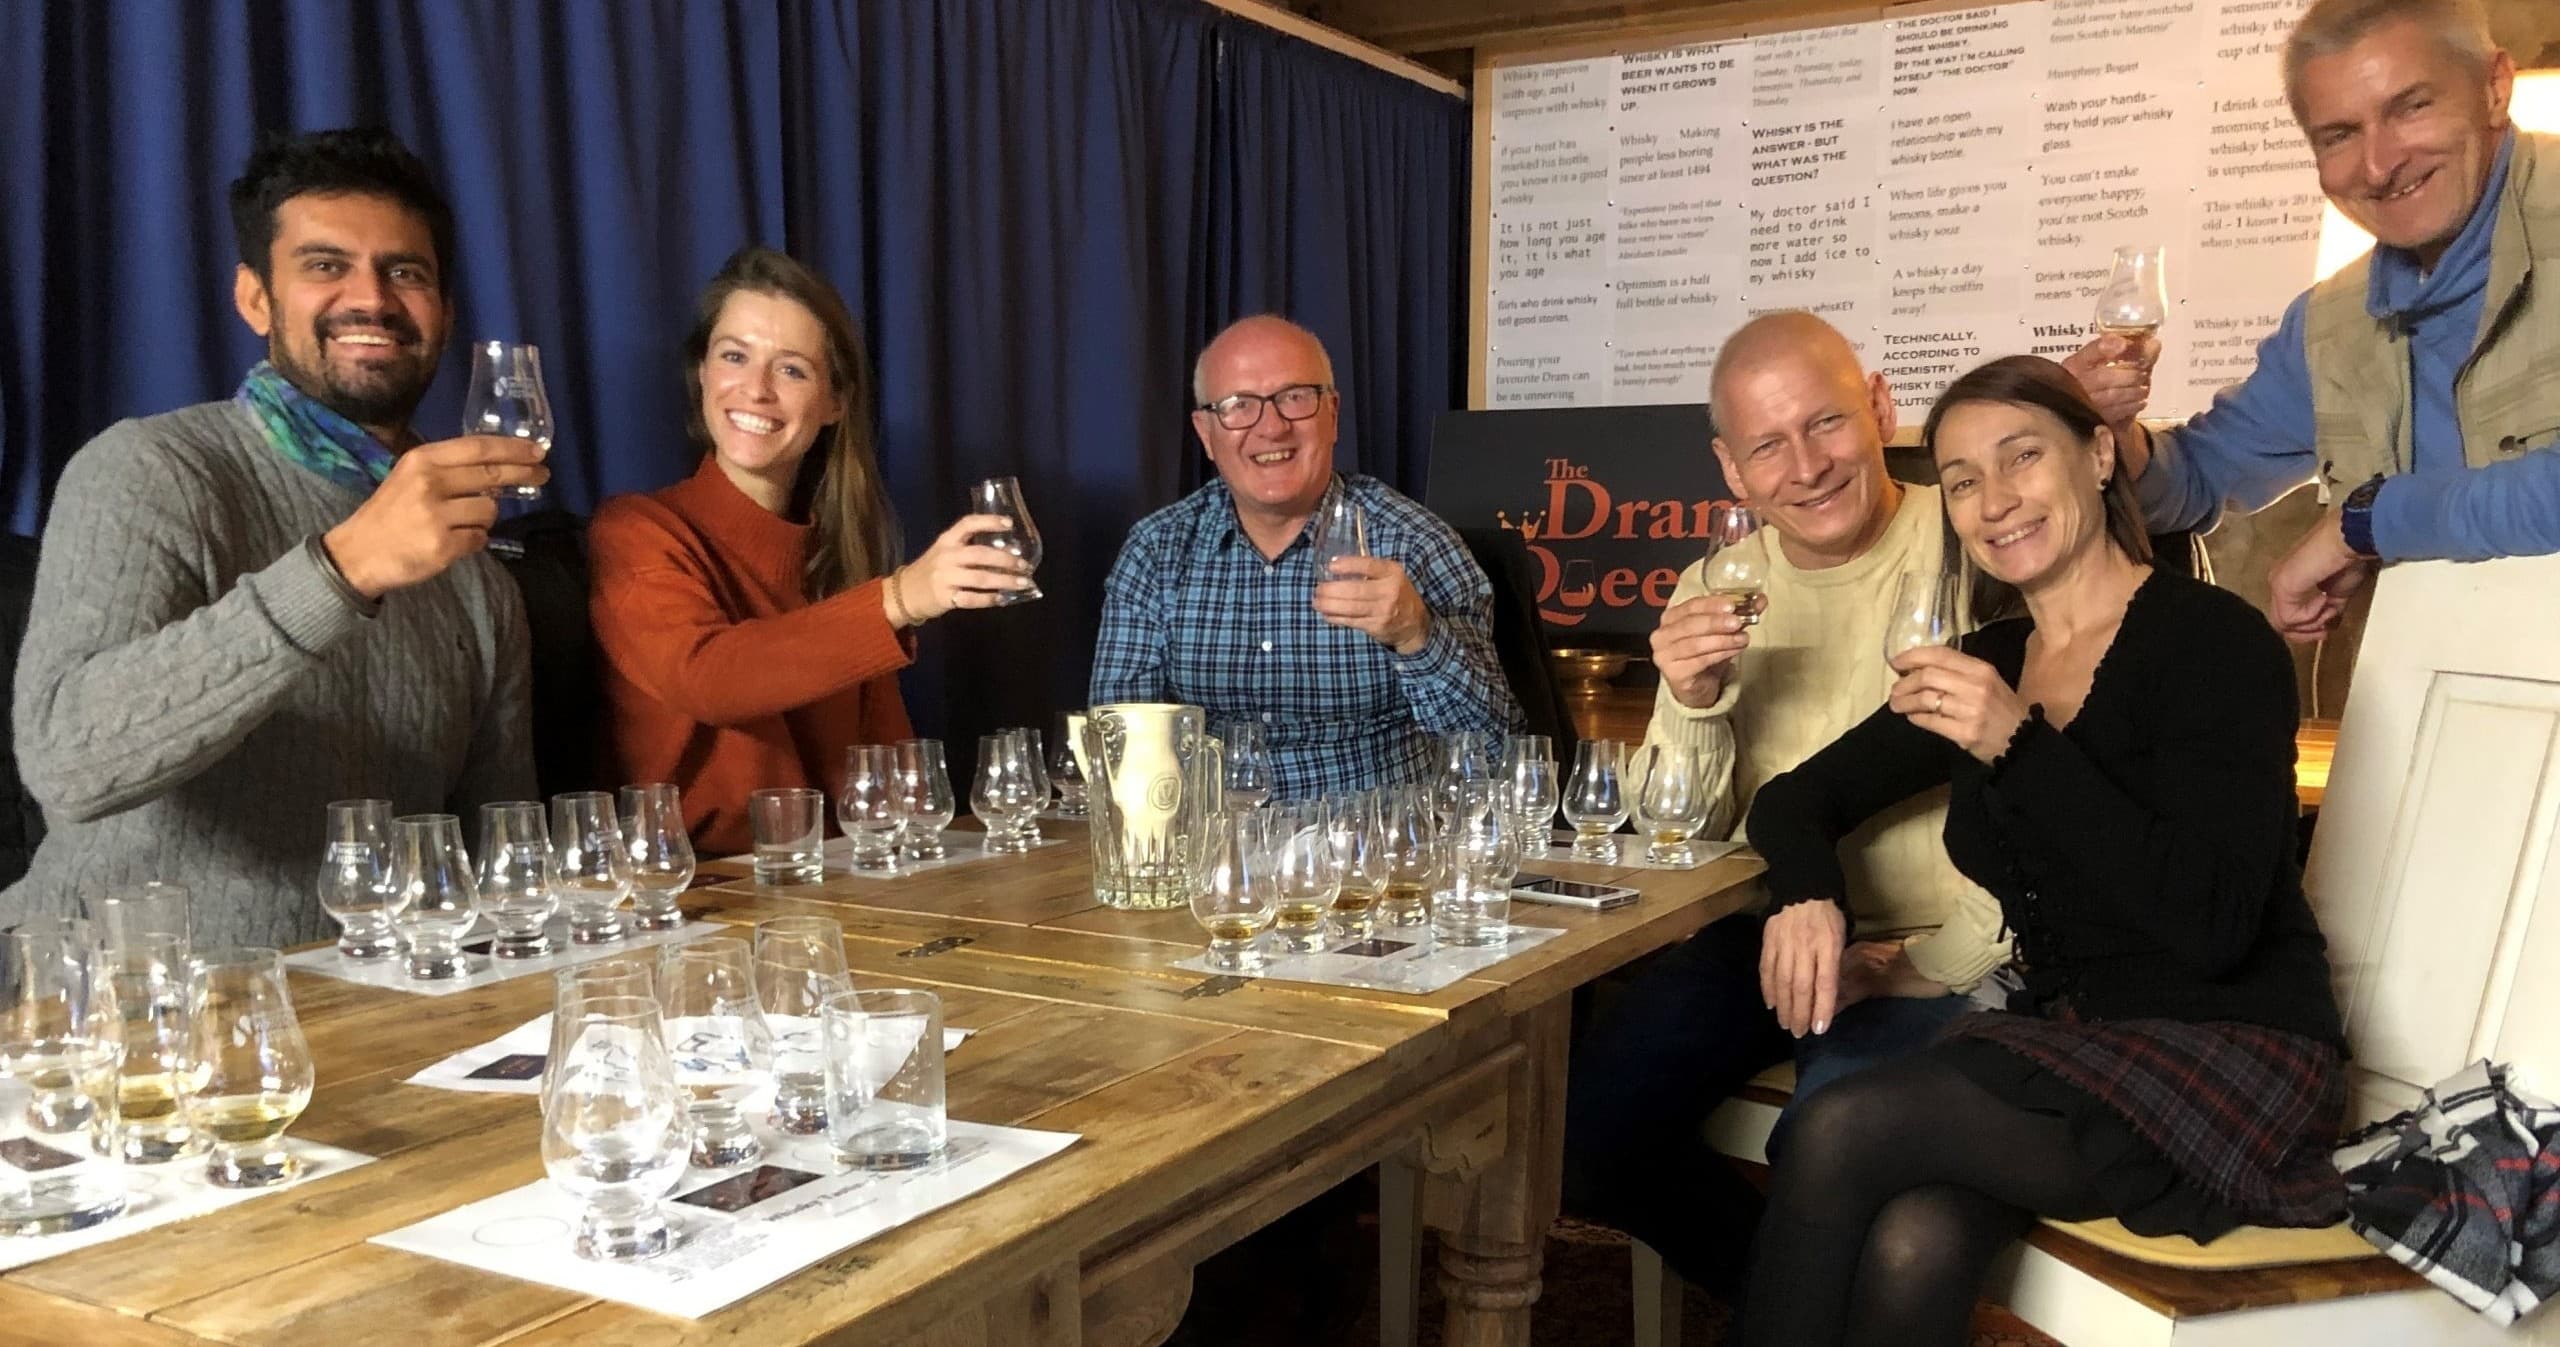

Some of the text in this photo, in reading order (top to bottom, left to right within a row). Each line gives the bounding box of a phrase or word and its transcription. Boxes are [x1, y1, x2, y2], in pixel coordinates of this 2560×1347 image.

[1897, 20, 1917, 29] THE
[1920, 14, 1963, 27] DOCTOR
[1965, 10, 1990, 19] SAID
[1895, 30, 1938, 43] SHOULD
[1940, 27, 1953, 37] BE
[1895, 45, 1924, 55] MORE
[1912, 59, 1931, 67] THE
[1934, 56, 1957, 65] WAY
[1978, 46, 2025, 59] CALLING
[1621, 59, 1734, 80] BEER WANTS TO BE
[1893, 71, 1933, 83] MYSELF
[1621, 77, 1717, 96] WHEN IT GROWS
[2045, 101, 2077, 113] Wash
[2081, 98, 2107, 111] your
[2110, 91, 2147, 105] hands
[2222, 98, 2258, 112] drink
[1805, 122, 1816, 132] IS
[1820, 119, 1844, 129] THE
[1898, 117, 1924, 129] have
[2073, 115, 2099, 129] hold
[2102, 115, 2129, 128] your
[2132, 108, 2174, 122] whisky
[1891, 125, 2004, 147] relationship with my
[1752, 140, 1805, 155] ANSWER
[1814, 135, 1839, 147] BUT
[1752, 150, 1847, 171] WHAT WAS THE
[1890, 152, 1928, 166] whisky
[2040, 173, 2066, 186] You
[2103, 166, 2139, 179] make
[2207, 158, 2318, 178] is unprofessiona
[1751, 168, 1819, 187] QUESTION?
[1890, 188, 1924, 202] When
[1927, 186, 1947, 200] life
[1983, 181, 2007, 196] you
[2038, 192, 2099, 207] everyone
[1750, 196, 1870, 222] My doctor said I
[1937, 204, 1970, 217] make
[2081, 211, 2103, 223] not
[2106, 206, 2148, 221] Scotch
[1501, 217, 1592, 234] It is not just
[1750, 216, 1847, 236] need to drink
[1888, 225, 1961, 242] whisky sour
[1500, 233, 1606, 249] how long you age
[1750, 233, 1847, 252] more water so
[1527, 252, 1538, 262] it
[1547, 250, 1558, 260] is
[1564, 248, 1591, 259] what
[1750, 247, 1870, 268] now I add ice to
[1500, 267, 1545, 281] you age
[1749, 266, 1816, 286] my whisky
[1892, 262, 1984, 281] A whisky a day
[2035, 270, 2065, 283] Drink
[1616, 274, 1710, 293] Optimism is a half
[1892, 284, 1925, 300] keeps
[1929, 282, 1946, 294] the
[1498, 293, 1598, 310] Girls who drink whisky
[1616, 292, 1718, 310] full bottle of whisky
[2035, 290, 2072, 300] means
[1498, 315, 1512, 327] tell
[1513, 314, 1536, 327] good
[2033, 324, 2086, 337] Whisky
[1883, 347, 1980, 361] ACCORDING TO
[2031, 343, 2082, 354] answer
[1934, 380, 1947, 390] IS
[1545, 458, 1589, 479] The
